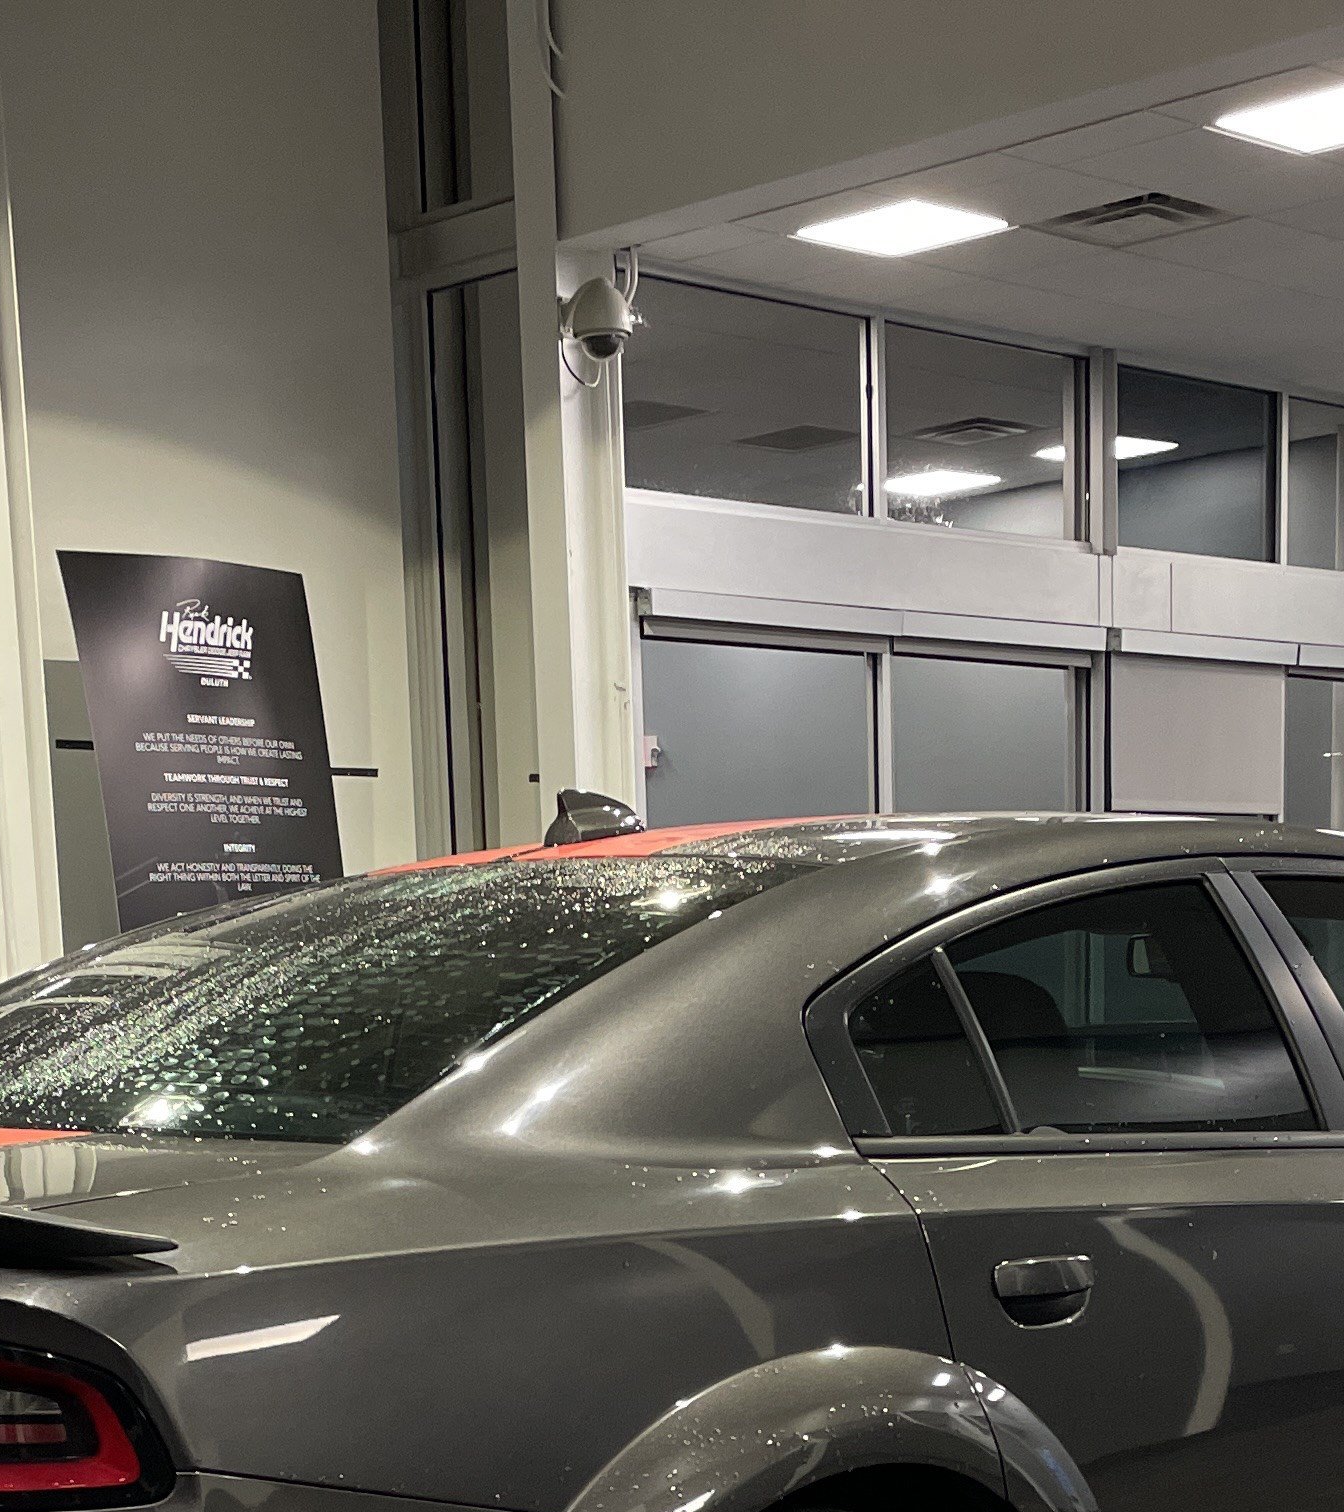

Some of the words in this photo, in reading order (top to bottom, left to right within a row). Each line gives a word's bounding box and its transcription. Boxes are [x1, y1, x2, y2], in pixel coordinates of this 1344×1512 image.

[159, 610, 254, 652] Hendrick
[200, 677, 229, 688] DULUTH
[186, 714, 218, 724] SERVANT
[218, 716, 256, 727] LEADERSHIP
[142, 732, 156, 742] WE
[157, 732, 171, 742] PUT
[171, 733, 185, 742] THE
[208, 734, 218, 744] OF
[265, 739, 278, 748] OUR
[135, 742, 169, 752] BECAUSE
[170, 743, 200, 753] SERVING
[200, 744, 223, 754] PEOPLE
[224, 746, 230, 755] IS
[230, 747, 246, 756] HOW
[164, 772, 207, 782] TEAMWORK
[208, 774, 240, 784] THROUGH
[151, 792, 186, 802] DIVERSITY
[186, 793, 194, 802] IS
[230, 795, 243, 804] AND
[290, 798, 303, 807] AND
[148, 803, 178, 812] RESPECT
[179, 803, 195, 812] ONE
[228, 805, 239, 813] WE
[210, 814, 228, 824] LEVEL
[223, 843, 256, 852] INTEGRITY
[156, 862, 170, 872] WE
[171, 862, 185, 872] ACT
[186, 862, 221, 872] HONESTLY
[221, 863, 236, 872] AND
[149, 873, 172, 881] RIGHT
[173, 873, 196, 881] THING
[197, 873, 221, 882] WITHIN
[222, 873, 239, 882] BOTH
[301, 874, 309, 883] OF
